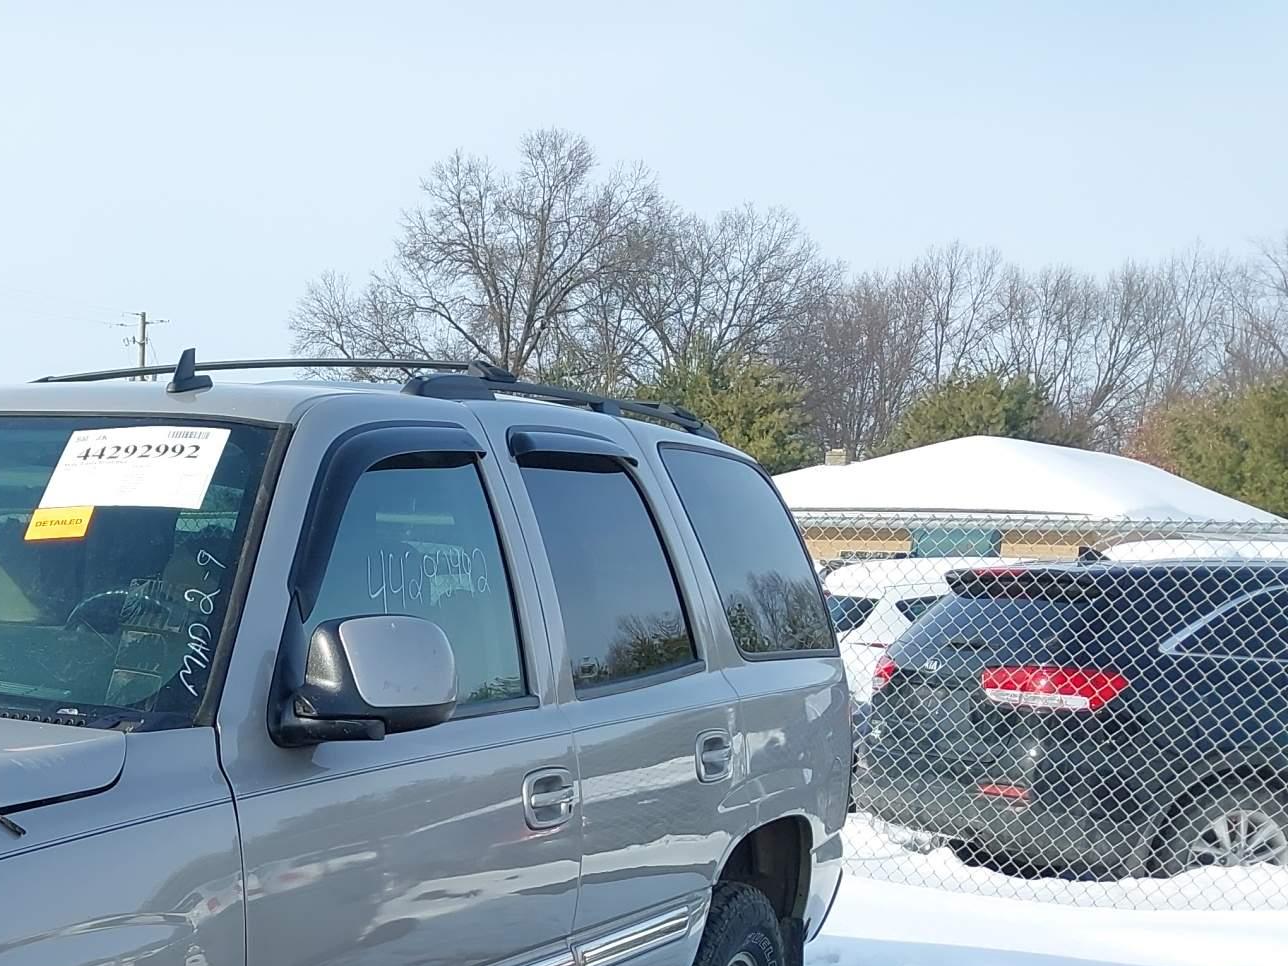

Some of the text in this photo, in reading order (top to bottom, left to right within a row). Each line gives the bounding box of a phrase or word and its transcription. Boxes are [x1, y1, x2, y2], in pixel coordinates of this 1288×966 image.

[76, 443, 201, 461] 44292992
[34, 518, 83, 528] DETAILED
[179, 623, 212, 697] MAD
